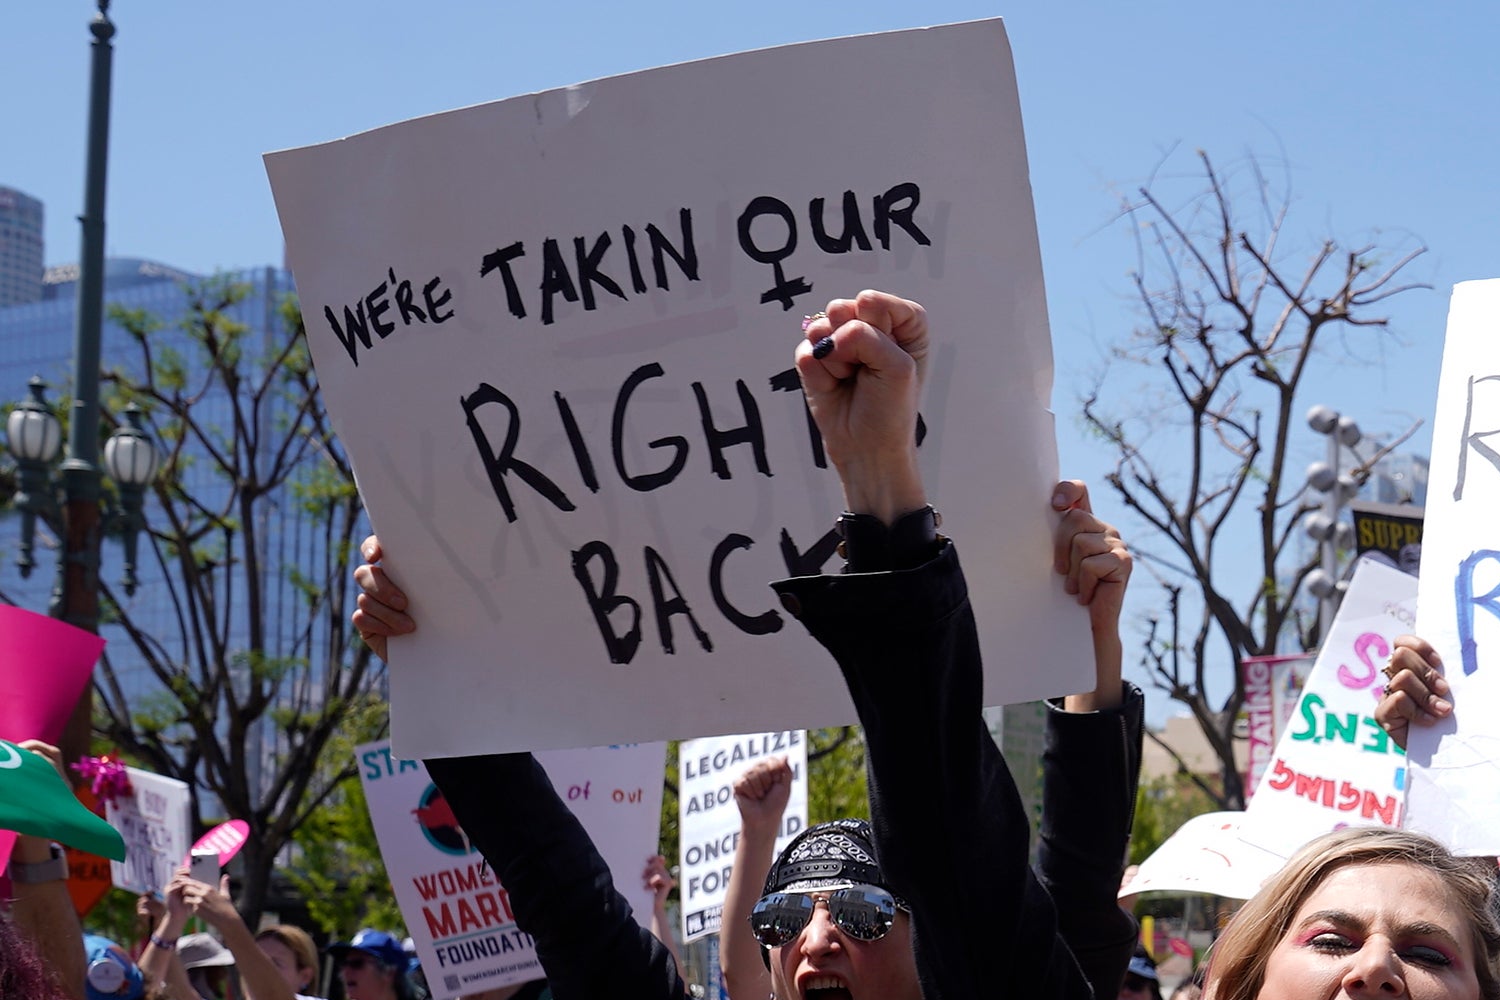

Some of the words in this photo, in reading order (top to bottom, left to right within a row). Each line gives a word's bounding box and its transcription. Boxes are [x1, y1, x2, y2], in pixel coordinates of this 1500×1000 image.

[324, 268, 456, 367] WE'RE
[480, 207, 700, 324] TAKIN
[460, 362, 928, 524] RIGHT
[1247, 661, 1273, 795] BRATING
[1291, 693, 1406, 756] EN'S
[685, 730, 801, 781] LEGALIZE
[686, 766, 800, 816] ABON
[1269, 759, 1403, 828] NGING
[413, 861, 502, 902] WOME
[422, 889, 515, 940] MARC
[436, 929, 535, 968] FOUNDATI
